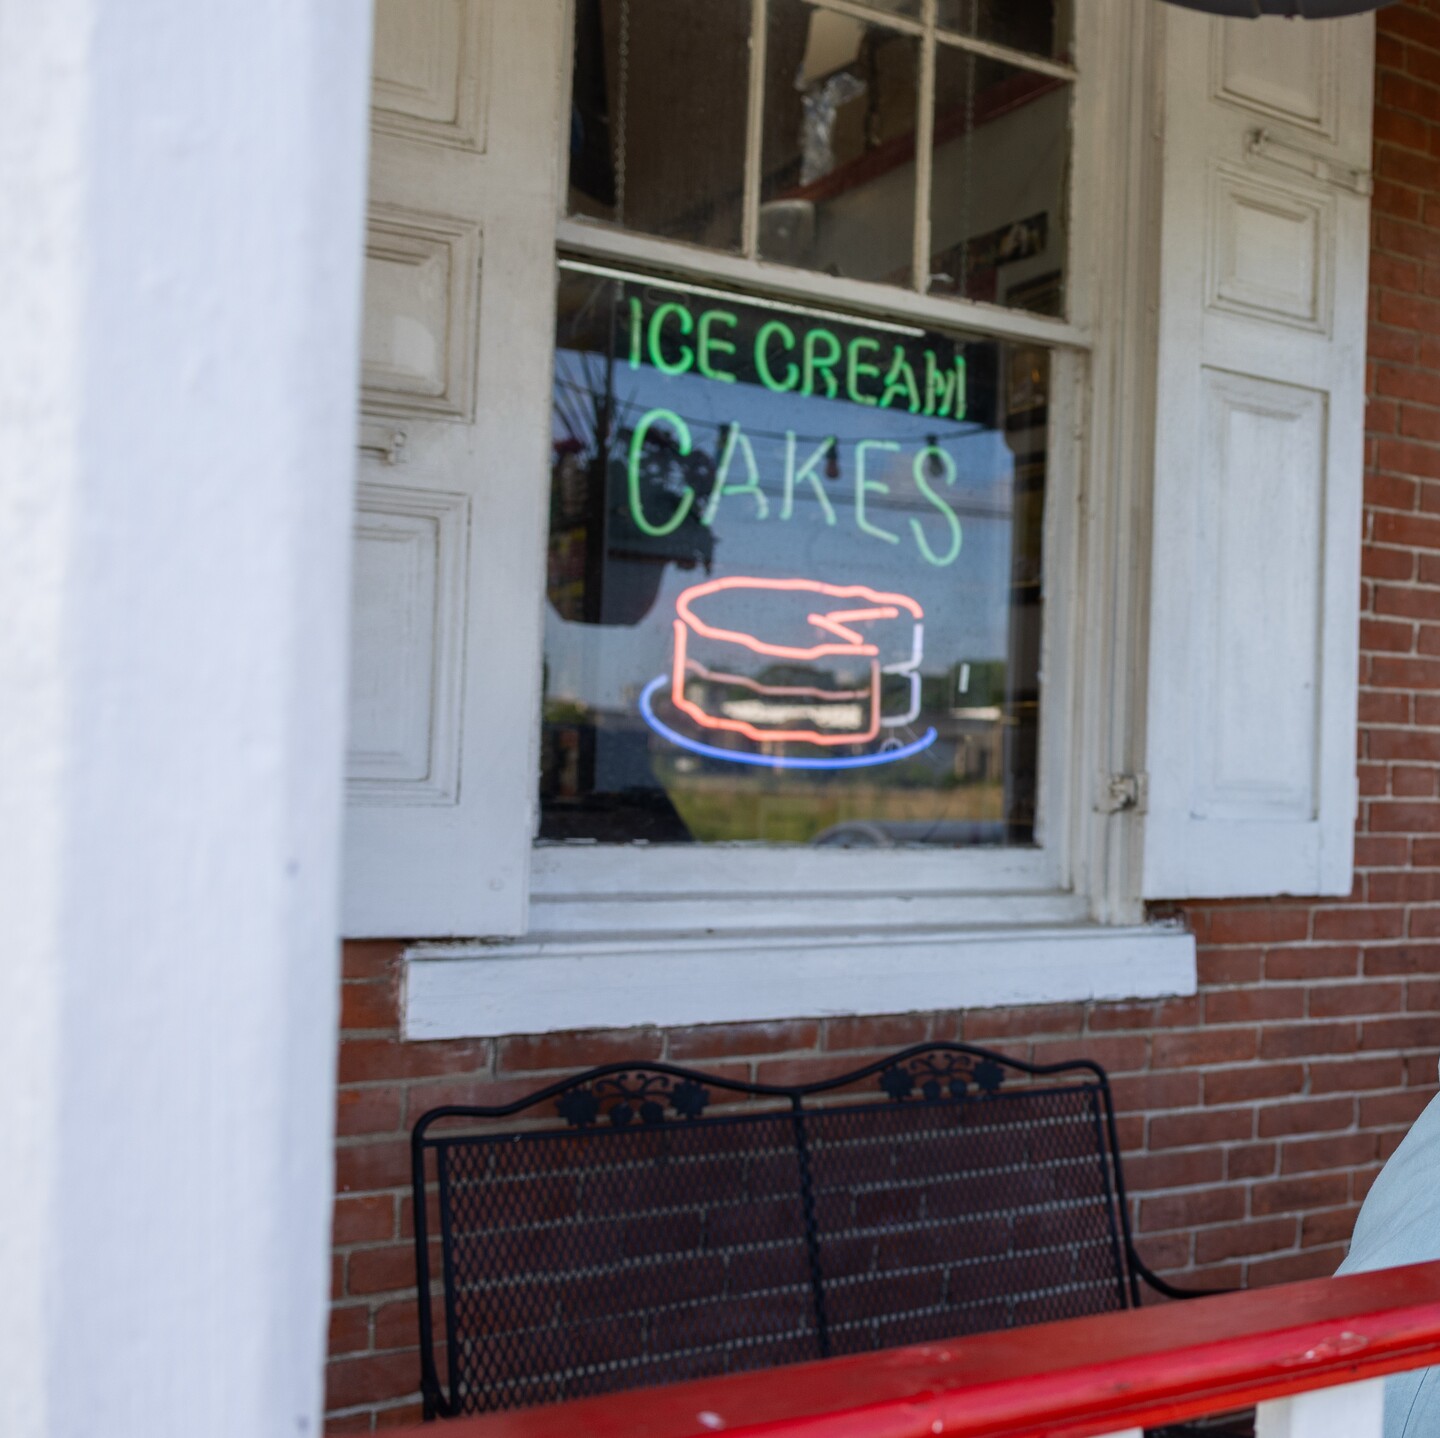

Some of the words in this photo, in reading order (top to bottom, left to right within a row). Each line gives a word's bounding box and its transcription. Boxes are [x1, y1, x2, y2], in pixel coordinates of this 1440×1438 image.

[630, 297, 737, 382] ICE
[755, 320, 967, 420] CREAM
[628, 408, 963, 567] CAKES
